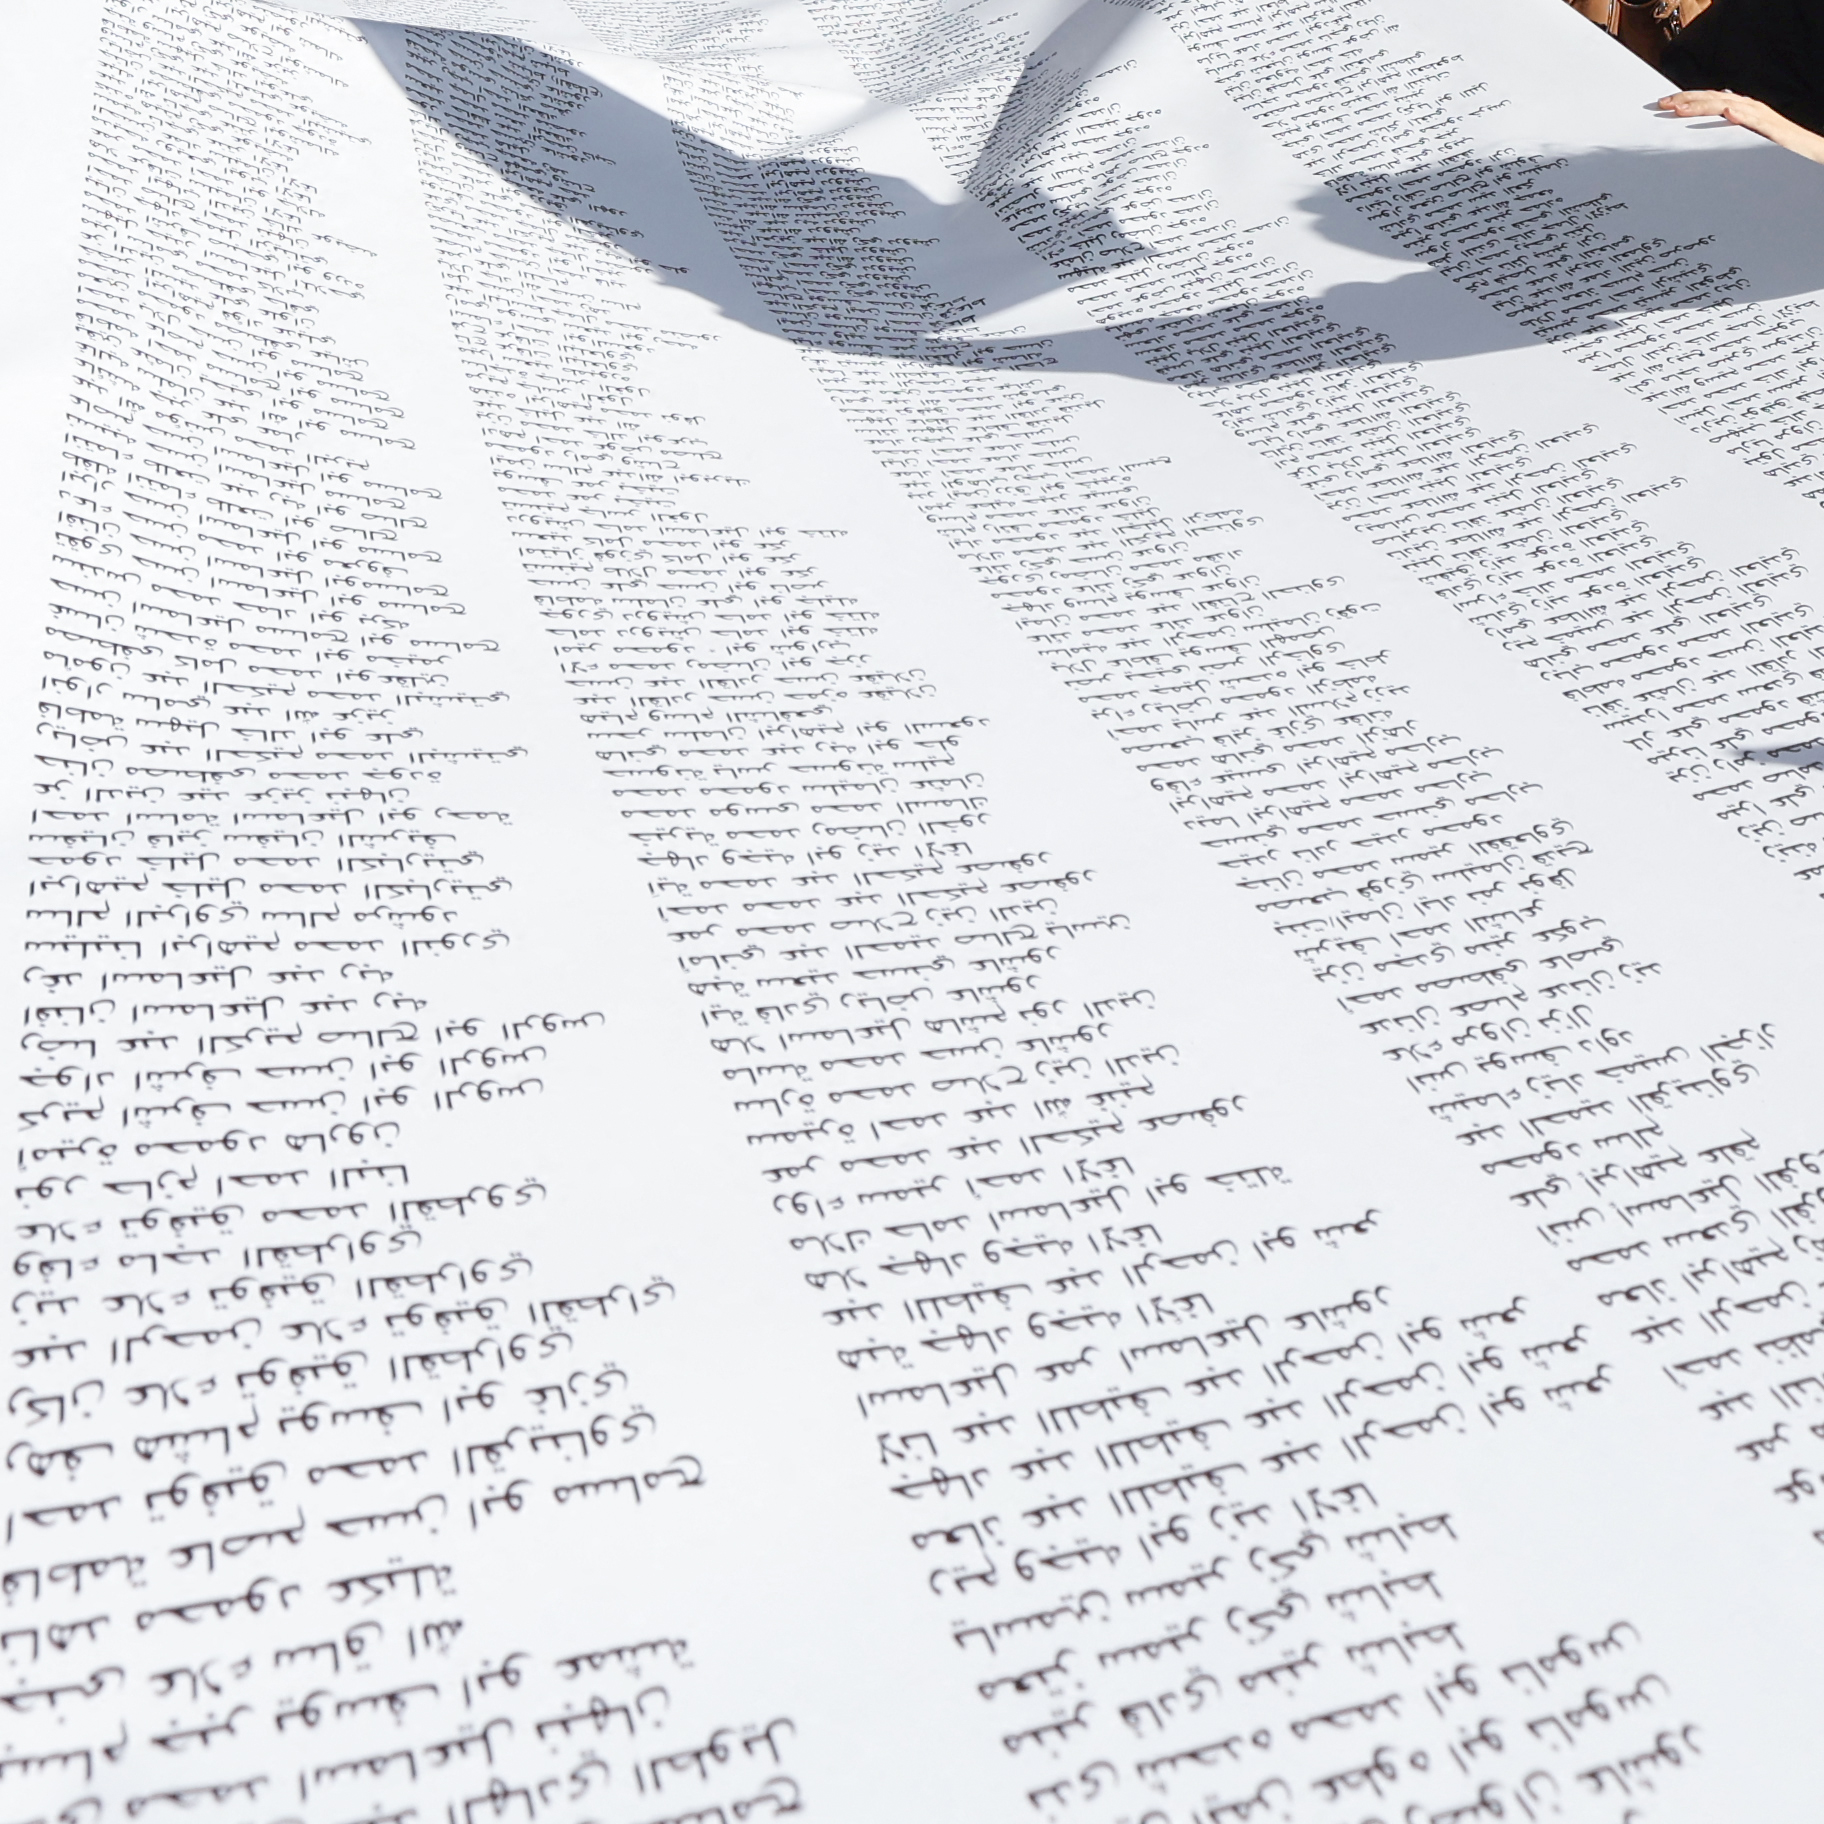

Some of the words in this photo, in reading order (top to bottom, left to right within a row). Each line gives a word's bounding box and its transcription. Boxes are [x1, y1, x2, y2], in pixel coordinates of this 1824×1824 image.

[1666, 716, 1708, 738] علي
[1717, 699, 1788, 724] محمود
[28, 830, 136, 848] سفيان
[146, 828, 208, 848] فايز
[222, 829, 325, 848] سفيان
[338, 828, 457, 848] الشريف
[29, 873, 149, 897] ابراهيم
[161, 877, 246, 899] خليل
[259, 882, 347, 895] محمد
[364, 876, 513, 900] الكباريتي
[24, 934, 142, 960] سيلينا
[161, 931, 281, 959] ابراهيم
[293, 939, 384, 952] محمد
[401, 928, 511, 957] النوري
[20, 1031, 97, 1058] رضا
[117, 1030, 179, 1052] عبد
[198, 1022, 303, 1055] الكريم
[317, 1021, 418, 1048] صالح
[435, 1017, 481, 1044] ابو
[501, 1011, 606, 1040] الروس
[1382, 1039, 1443, 1062] علاء
[1451, 1017, 1530, 1047] مروان
[1537, 1003, 1592, 1030] نزال
[17, 1136, 118, 1167] أميرة
[134, 1128, 267, 1156] محمود
[284, 1121, 400, 1153] هارون
[1480, 1140, 1580, 1176] محمود
[1592, 1122, 1664, 1149] سالم
[12, 1250, 99, 1280] وفاء
[118, 1248, 221, 1274] ماجد
[243, 1229, 422, 1268] القطراوي
[804, 1268, 868, 1290] هلا
[878, 1250, 966, 1277] جهاد
[982, 1238, 1074, 1264] وجيه
[1087, 1223, 1163, 1253] الاغا
[1565, 1240, 1649, 1272] محمد
[1662, 1204, 1755, 1247] سعدي
[5, 1440, 114, 1478] رهف
[133, 1408, 259, 1462] هشام
[277, 1400, 423, 1434] يوسف
[443, 1380, 497, 1423] ابو
[526, 1362, 628, 1409] غازي
[928, 1555, 997, 1596] ريم
[1013, 1545, 1121, 1582] وجيه
[1138, 1514, 1189, 1561] ابو
[1209, 1503, 1270, 1540] زيد
[1292, 1482, 1378, 1522] الاغا
[952, 1589, 1108, 1654] ياسمين
[1124, 1555, 1225, 1605] سمير
[1248, 1530, 1327, 1582] زكي
[1344, 1512, 1459, 1561] شابط
[0, 1615, 110, 1660] ناهد
[135, 1576, 300, 1631] محمود
[328, 1563, 452, 1601] عكيلة
[151, 1704, 248, 1750] جبر
[274, 1683, 439, 1732] يوسف
[462, 1652, 523, 1706] ابو
[556, 1637, 694, 1677] عمشة
